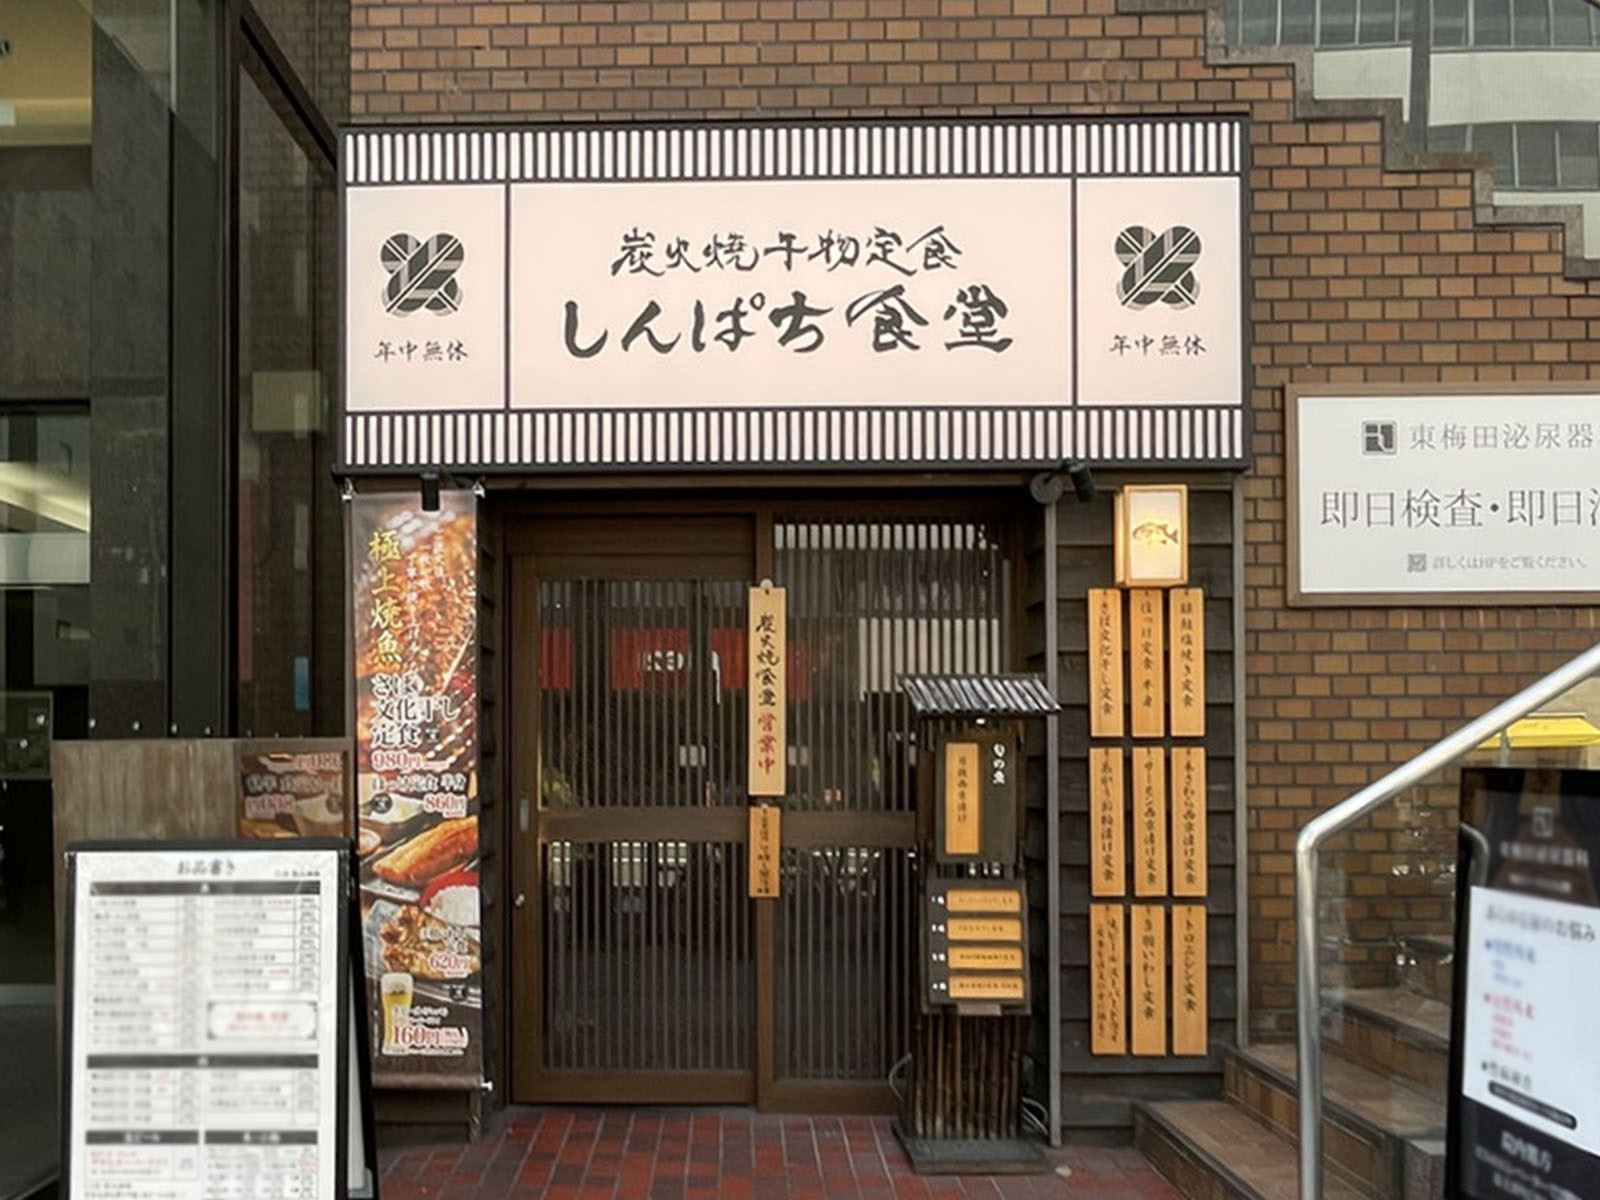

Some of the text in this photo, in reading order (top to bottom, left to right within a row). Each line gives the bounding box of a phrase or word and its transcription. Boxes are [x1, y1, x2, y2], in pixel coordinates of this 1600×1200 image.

[611, 225, 963, 278] 炭火焼干物定食
[564, 284, 1014, 359] しんぱち食堂
[1109, 334, 1207, 357] 年中無休
[374, 340, 468, 363] 年中無休
[368, 529, 402, 663] 極上焼魚
